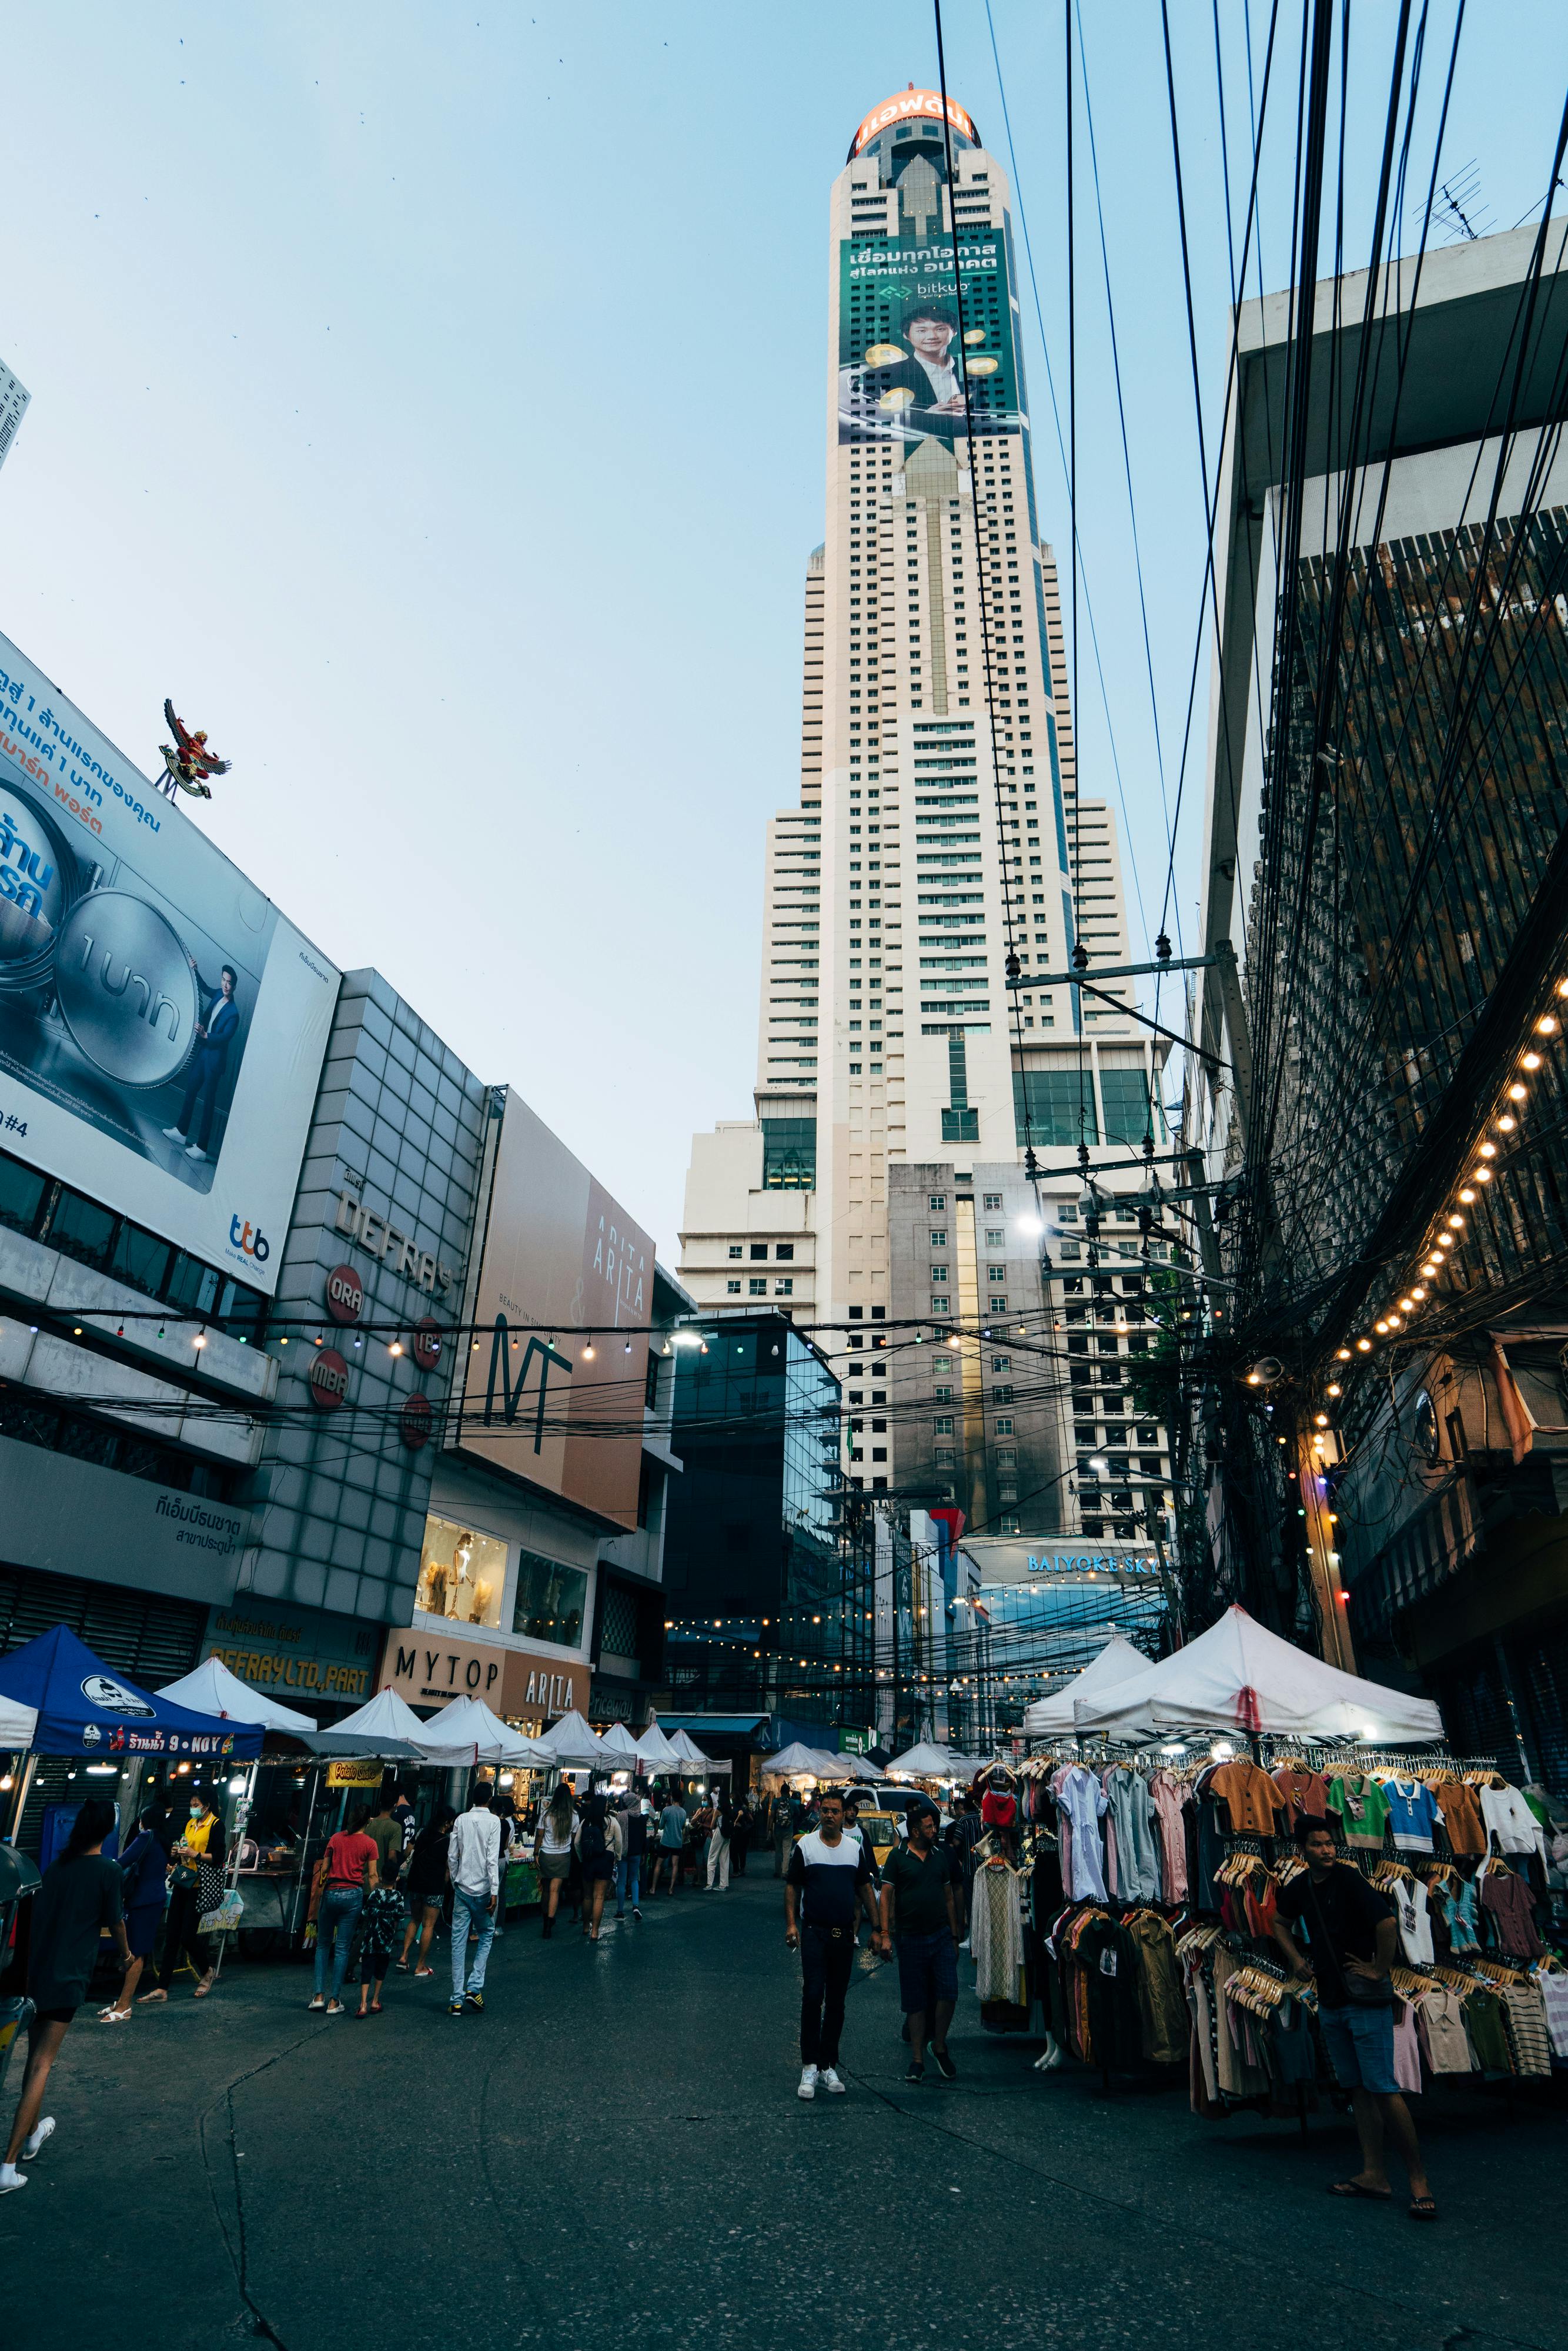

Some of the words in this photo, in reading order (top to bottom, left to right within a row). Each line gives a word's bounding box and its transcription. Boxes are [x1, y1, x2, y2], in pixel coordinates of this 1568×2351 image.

[27, 695, 36, 712] 1
[38, 708, 161, 833] ล้านแรกของคุณ
[59, 755, 67, 773] 1
[70, 769, 103, 808] บาท
[54, 782, 103, 835] พอร์ต
[100, 950, 180, 1042] บาท
[229, 1213, 270, 1262] ttb
[335, 1190, 452, 1300] DEFRAY
[225, 1248, 237, 1259] Make
[237, 1255, 249, 1266] REAL
[249, 1262, 265, 1275] Change
[330, 1277, 363, 1312] ORA
[593, 1237, 643, 1328] ARITA
[499, 1293, 522, 1316] BEAUTY
[523, 1310, 530, 1323] IN
[312, 1362, 349, 1397] MBA
[155, 1495, 241, 1536] ทีเอ็มบีธนชาต
[176, 1530, 236, 1556] สาขาประตูน้ำ
[1027, 1556, 1118, 1573] BAIYOKE
[1124, 1557, 1159, 1574] SKY
[526, 1671, 573, 1720] ARITA
[129, 1731, 166, 1751] ร้านน้ำ
[169, 1735, 179, 1752] 9
[191, 1736, 221, 1753] NOY
[336, 1763, 357, 1780] Potato
[357, 1765, 376, 1781] Shake
